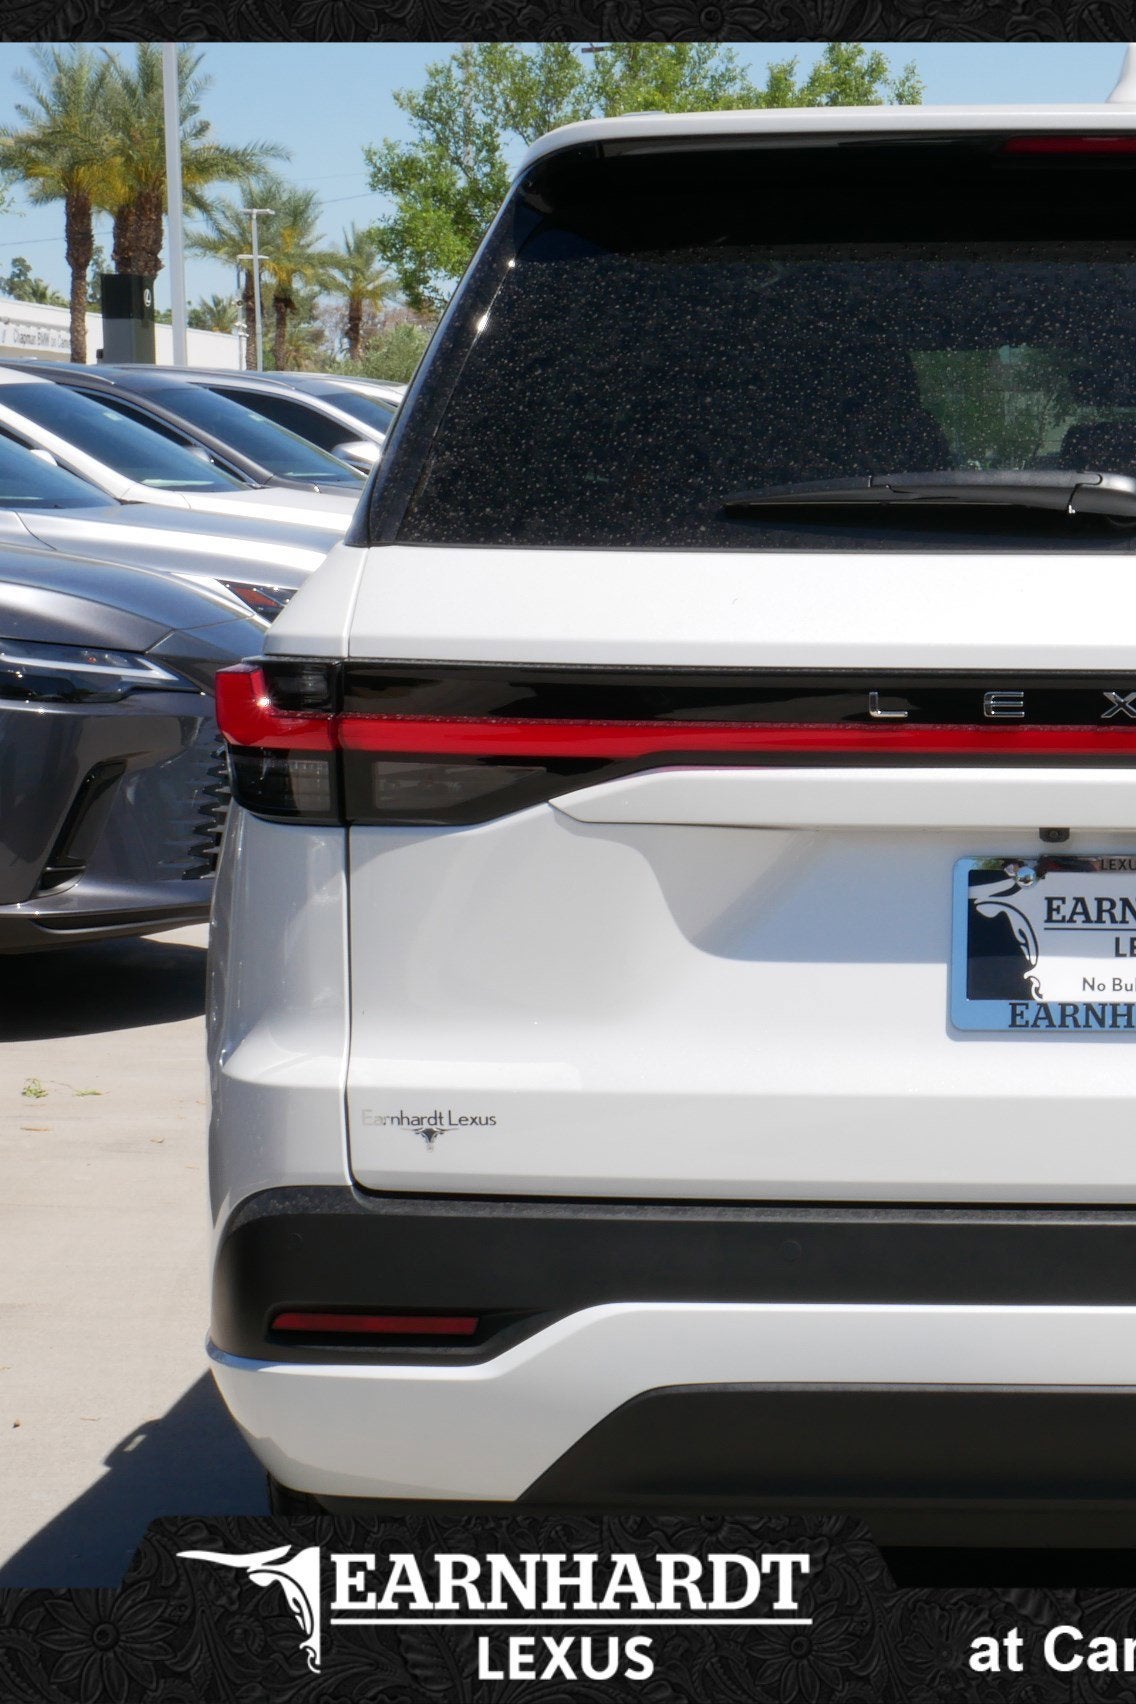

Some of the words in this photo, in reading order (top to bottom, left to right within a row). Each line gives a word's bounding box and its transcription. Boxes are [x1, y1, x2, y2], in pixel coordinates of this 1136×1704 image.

[1082, 977, 1106, 993] No
[361, 1109, 445, 1126] Earnhardt
[448, 1109, 497, 1126] Lexus
